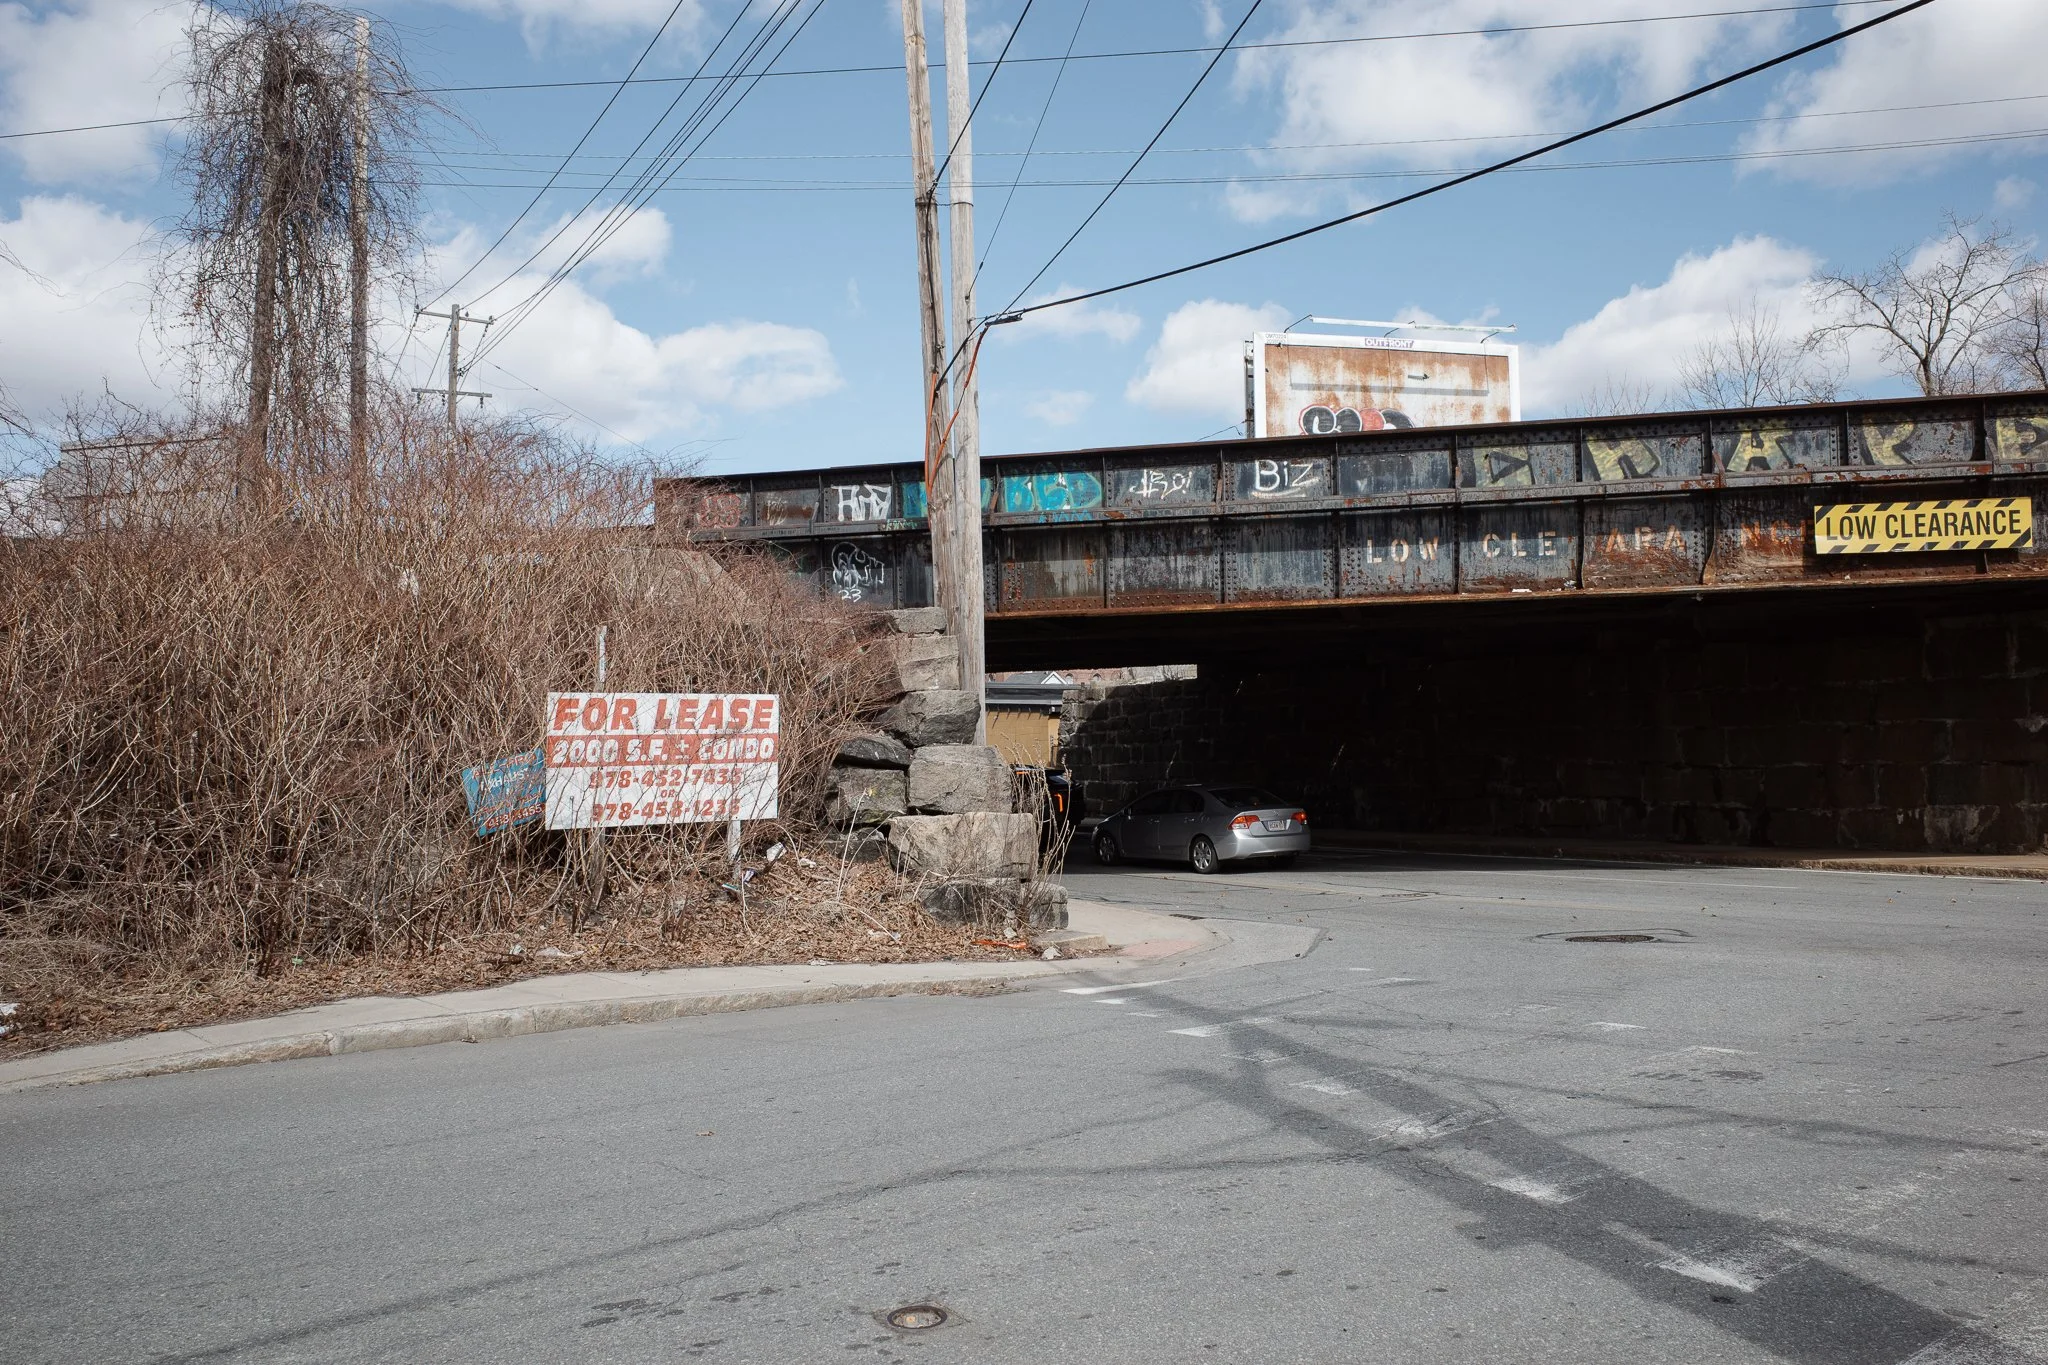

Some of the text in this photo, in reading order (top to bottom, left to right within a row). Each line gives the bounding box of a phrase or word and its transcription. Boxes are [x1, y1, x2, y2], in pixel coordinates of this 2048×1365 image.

[1366, 338, 1413, 349] OUTFRONT
[1826, 509, 2022, 540] LOW CLEARANCE
[1366, 536, 1439, 563] LOW
[838, 589, 861, 602] 23
[553, 697, 774, 731] FOR LEASE
[552, 739, 619, 764] 2000
[626, 739, 668, 763] S.F.
[699, 737, 775, 761] CONDO
[660, 789, 675, 799] OR
